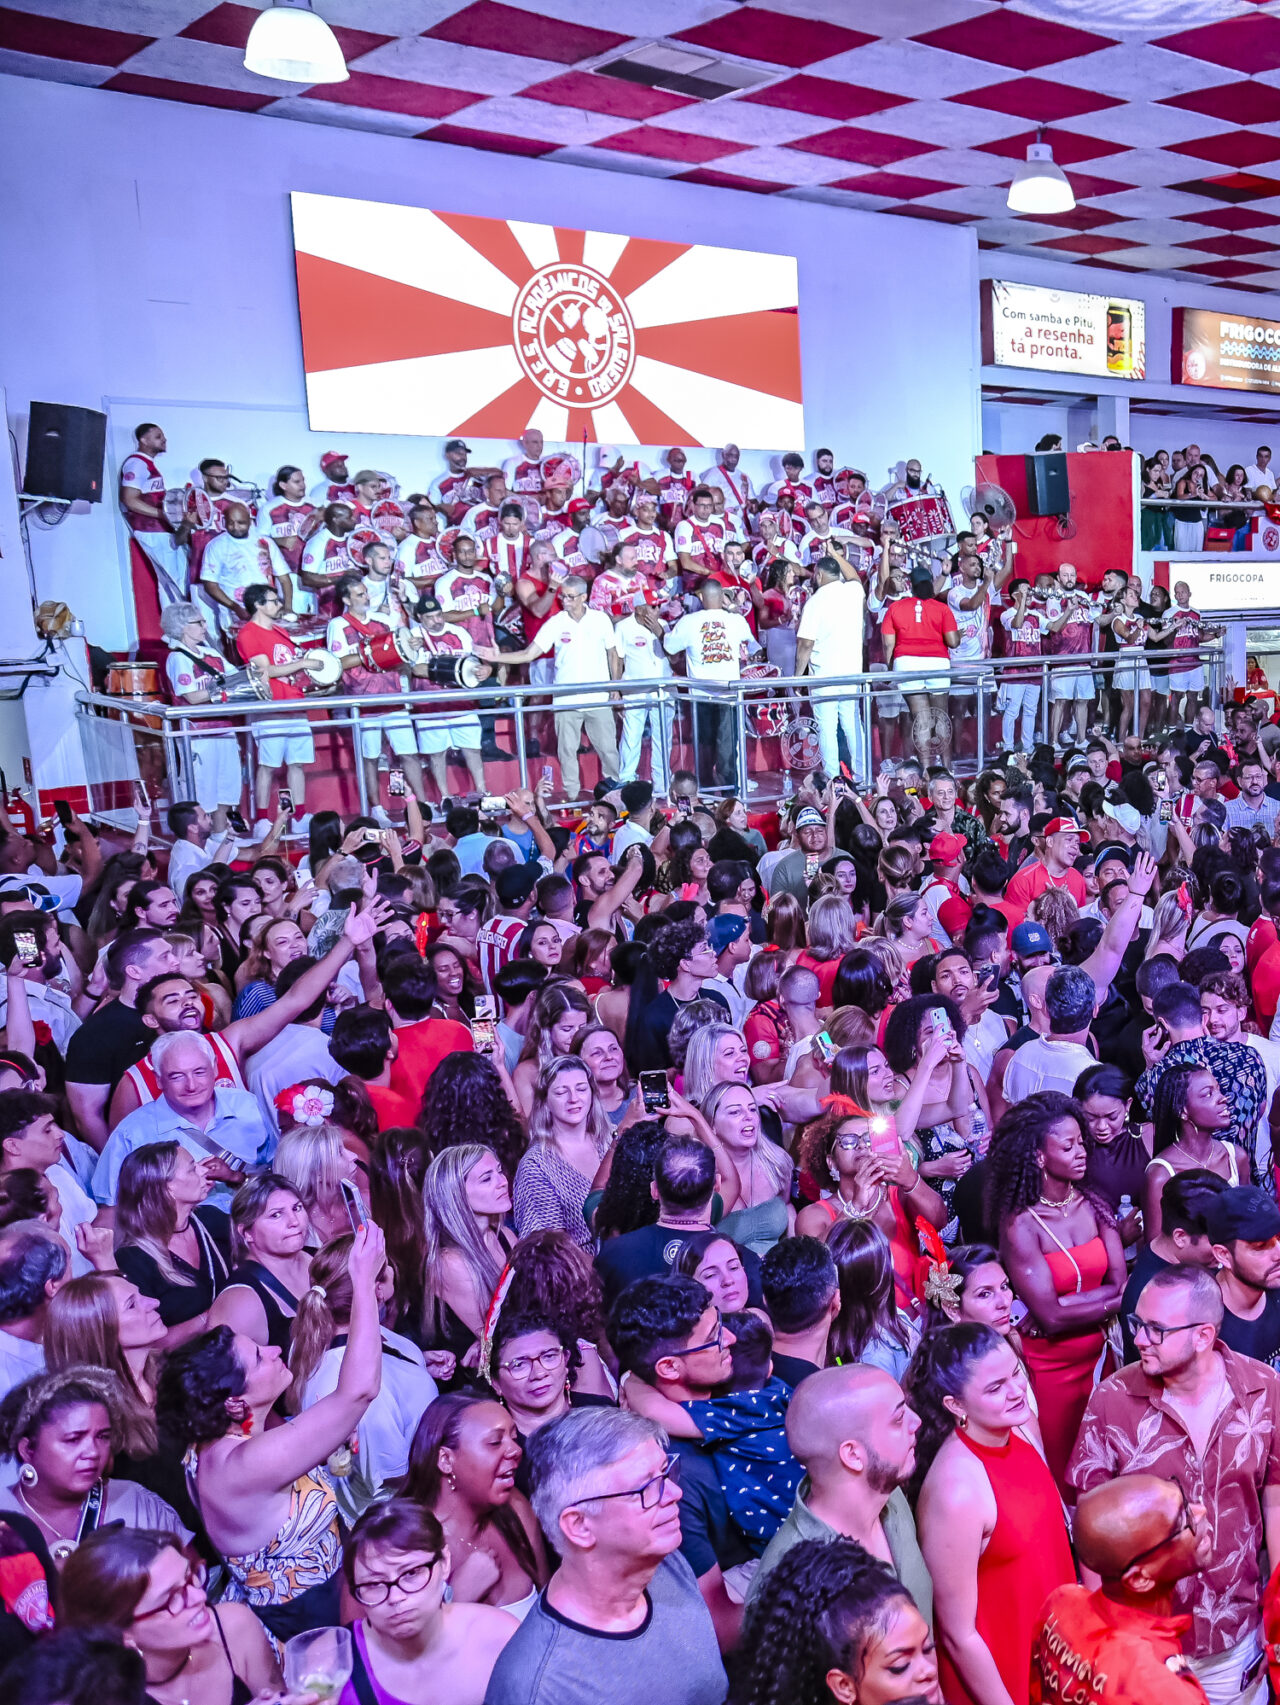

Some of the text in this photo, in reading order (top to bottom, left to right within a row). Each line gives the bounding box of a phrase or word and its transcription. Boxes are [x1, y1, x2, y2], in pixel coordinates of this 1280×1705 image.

[1002, 307, 1027, 320] Com
[1029, 312, 1062, 324] samba
[1065, 317, 1071, 326] e
[1024, 326, 1094, 345] a resenha
[1010, 338, 1083, 360] tá pronta.
[1209, 573, 1264, 583] FRIGOCOPA
